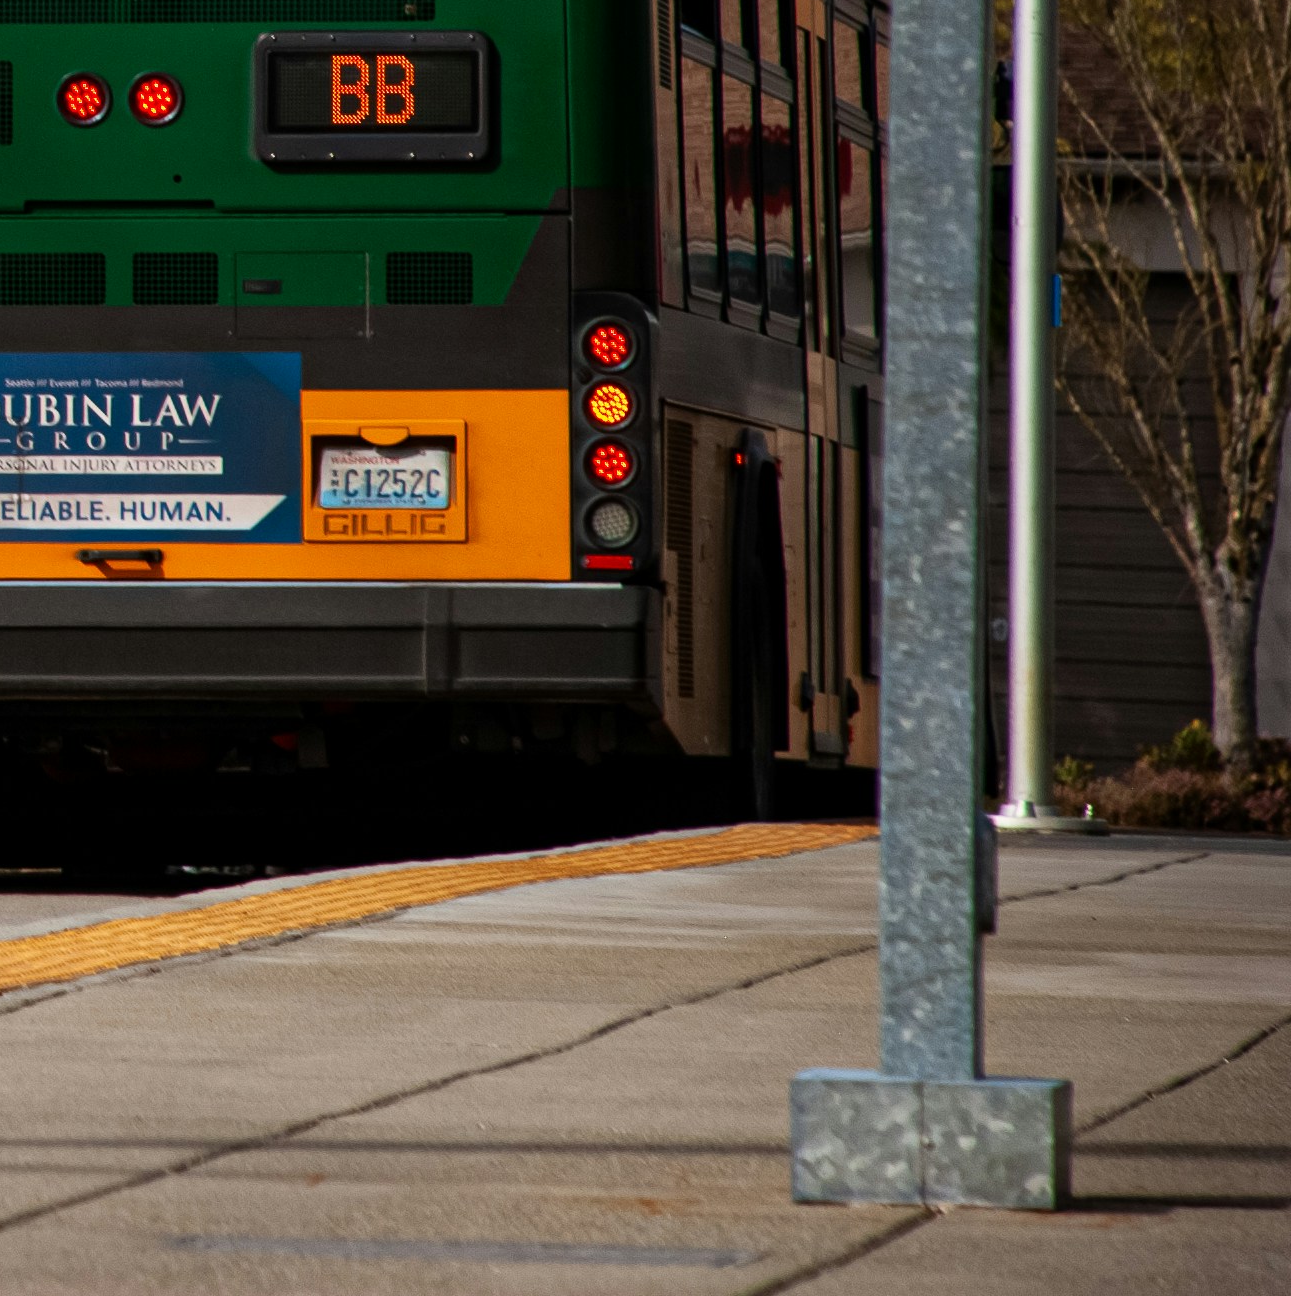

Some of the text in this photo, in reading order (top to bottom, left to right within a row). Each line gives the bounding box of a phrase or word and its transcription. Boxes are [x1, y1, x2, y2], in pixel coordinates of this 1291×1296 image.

[331, 54, 416, 125] BB
[130, 393, 223, 427] LAW
[16, 430, 175, 451] GROUP
[63, 457, 121, 474] INJURY
[124, 457, 217, 472] ATTORNEYS
[345, 468, 441, 499] C1252C
[120, 500, 231, 522] HUMAN.
[323, 513, 446, 536] GILLIG
